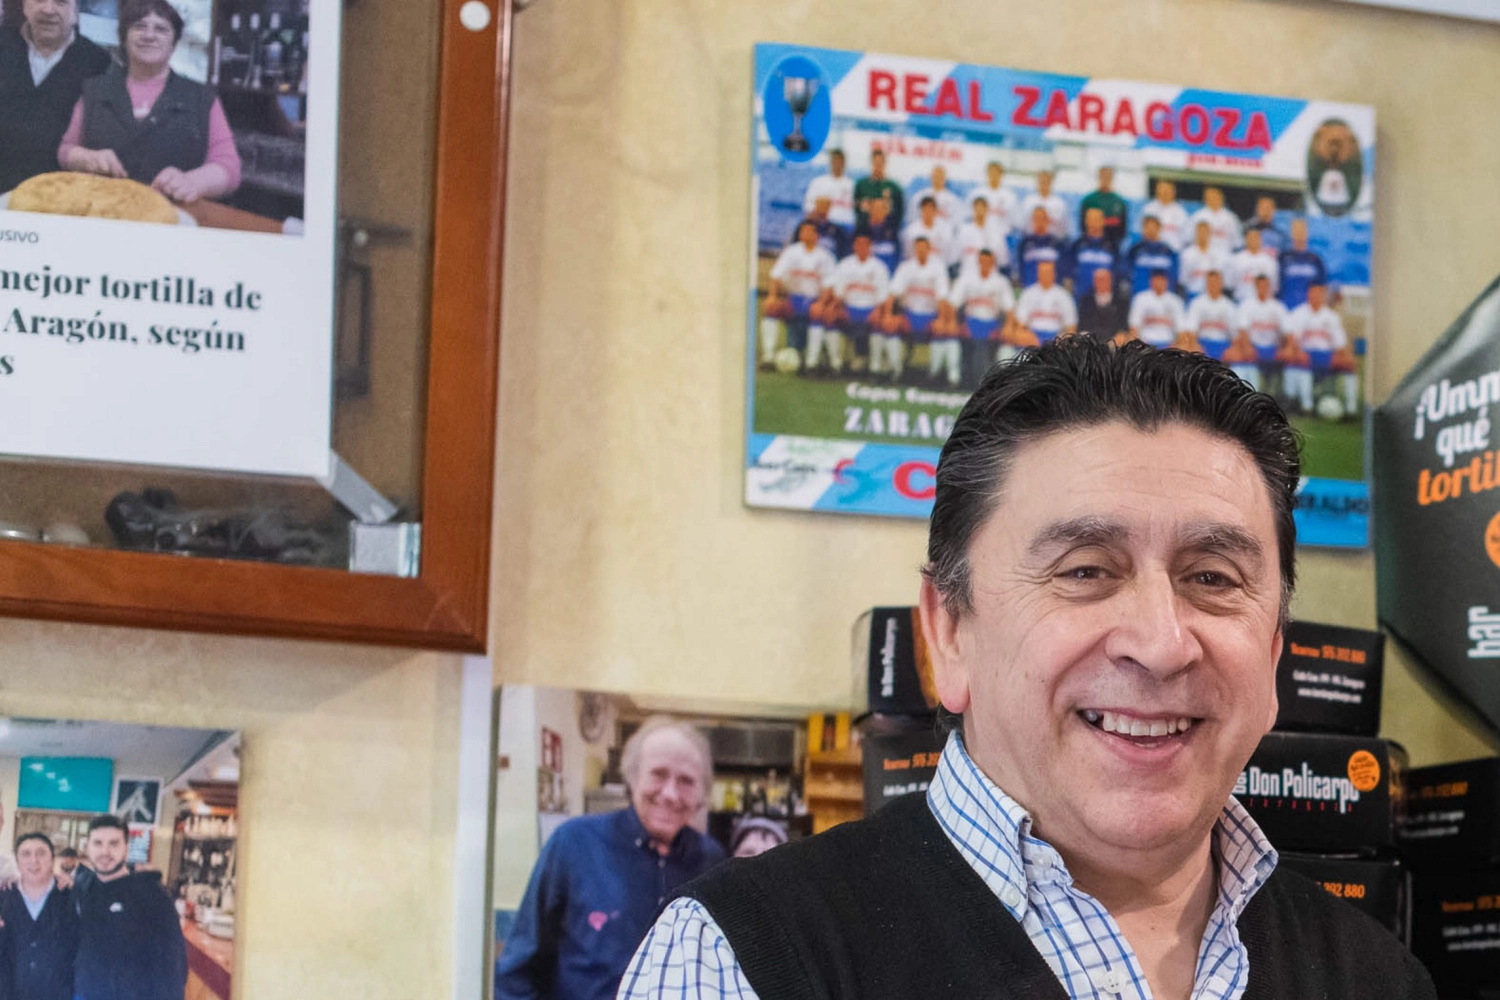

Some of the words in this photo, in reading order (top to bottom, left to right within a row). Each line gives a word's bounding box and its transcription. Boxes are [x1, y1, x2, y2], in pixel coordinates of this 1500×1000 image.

[868, 70, 993, 121] REAL
[1012, 86, 1272, 152] ZARAGOZA
[0, 265, 90, 298] mejor
[101, 274, 213, 306] tortilla
[225, 282, 262, 310] de
[3, 307, 138, 344] Aragón,
[148, 320, 245, 353] según
[844, 406, 954, 440] ZARAG
[1436, 404, 1491, 467] qué
[1250, 766, 1280, 797] Don
[1344, 883, 1365, 898] 880
